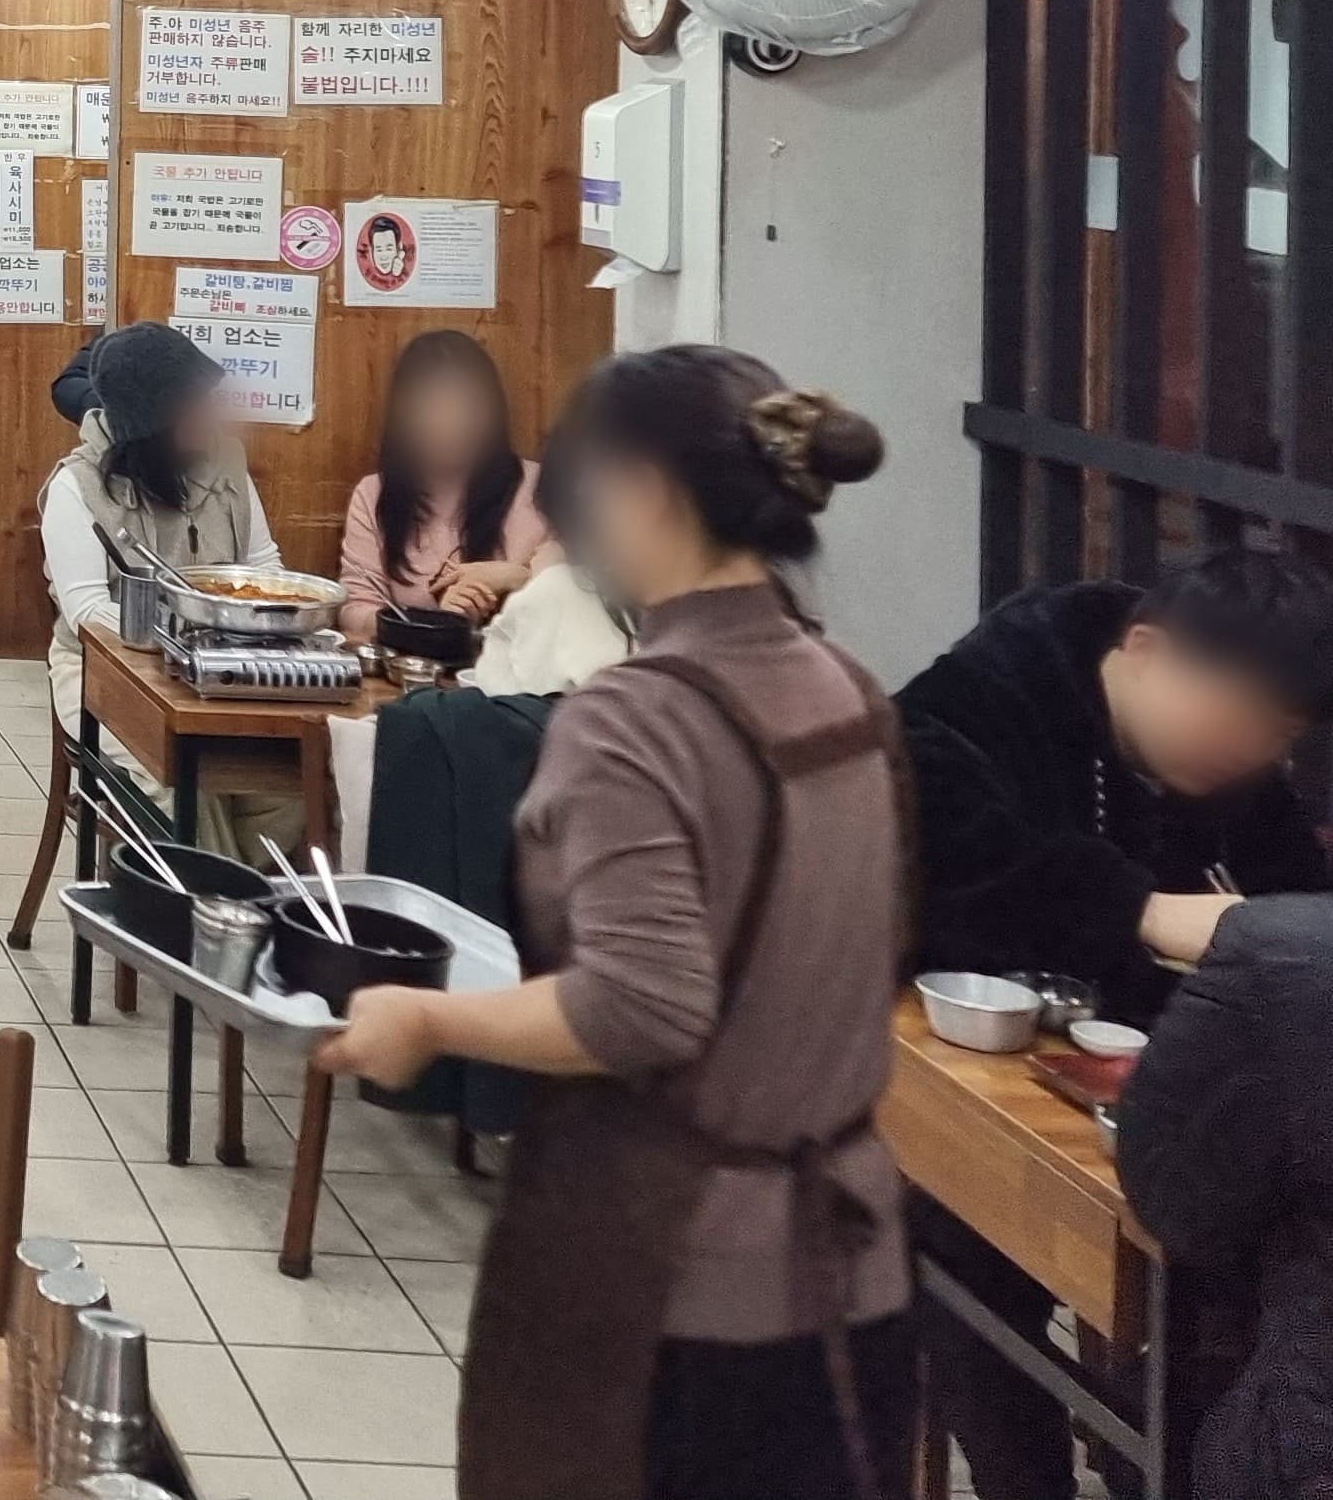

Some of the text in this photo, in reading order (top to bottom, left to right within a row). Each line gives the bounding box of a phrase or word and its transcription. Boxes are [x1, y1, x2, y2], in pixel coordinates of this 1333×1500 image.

[189, 17, 231, 33] 미성년
[237, 19, 266, 34] 음주
[300, 21, 436, 38] 함께 자리한 미성년
[148, 31, 272, 49] 판매하지 않습니다.
[148, 55, 267, 72] 미성년자 주류판매
[300, 45, 432, 65] 술!! 주지마세요
[146, 71, 222, 87] 거부합니다.
[300, 75, 429, 96] 불법입니다.!!!
[146, 91, 180, 105] 미성년
[185, 92, 232, 107] 음주하지
[152, 165, 263, 182] 국물 추가 안됩니다
[7, 165, 23, 225] 육사시미
[0, 256, 41, 271] 업소는
[224, 325, 283, 349] 업소는
